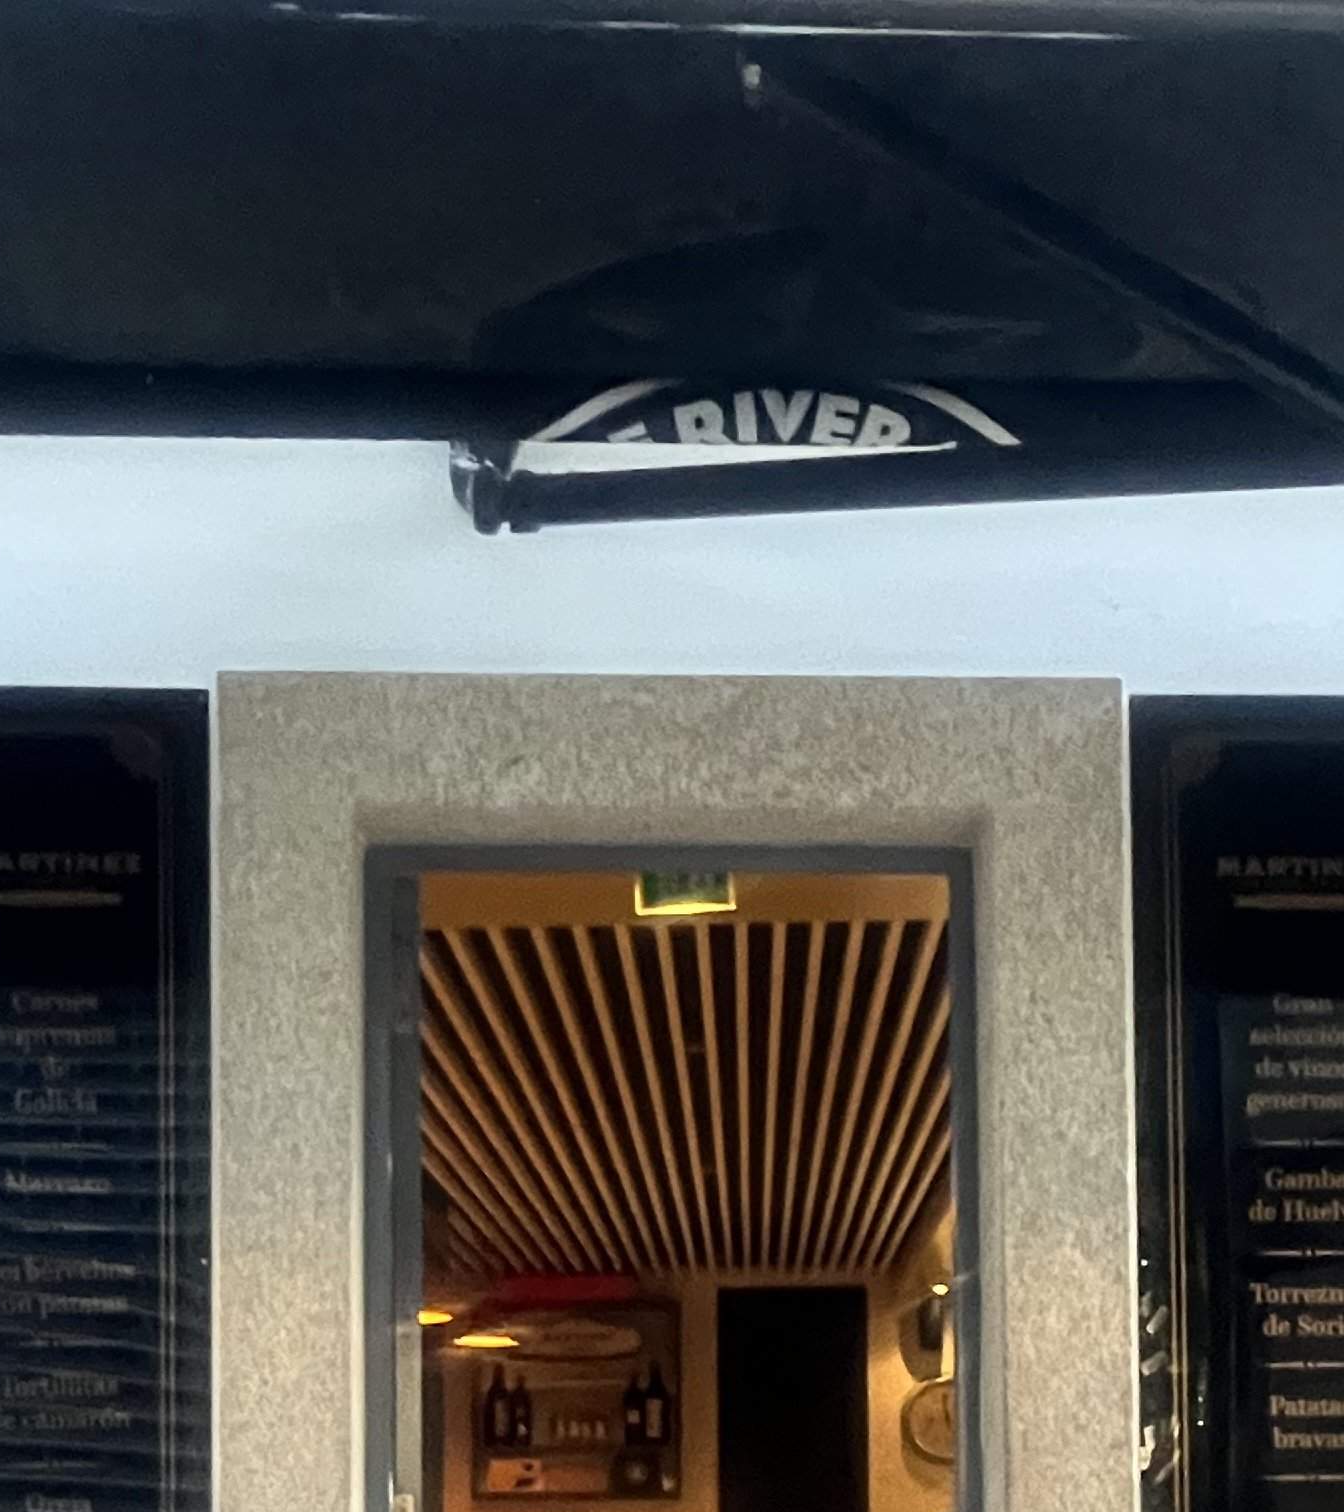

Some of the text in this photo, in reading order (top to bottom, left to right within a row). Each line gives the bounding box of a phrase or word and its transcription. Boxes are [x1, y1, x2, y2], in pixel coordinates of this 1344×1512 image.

[673, 389, 912, 448] RIVER
[1271, 994, 1334, 1016] Gran
[1254, 1055, 1284, 1079] de
[1248, 1198, 1277, 1223] de
[1262, 1314, 1291, 1338] de
